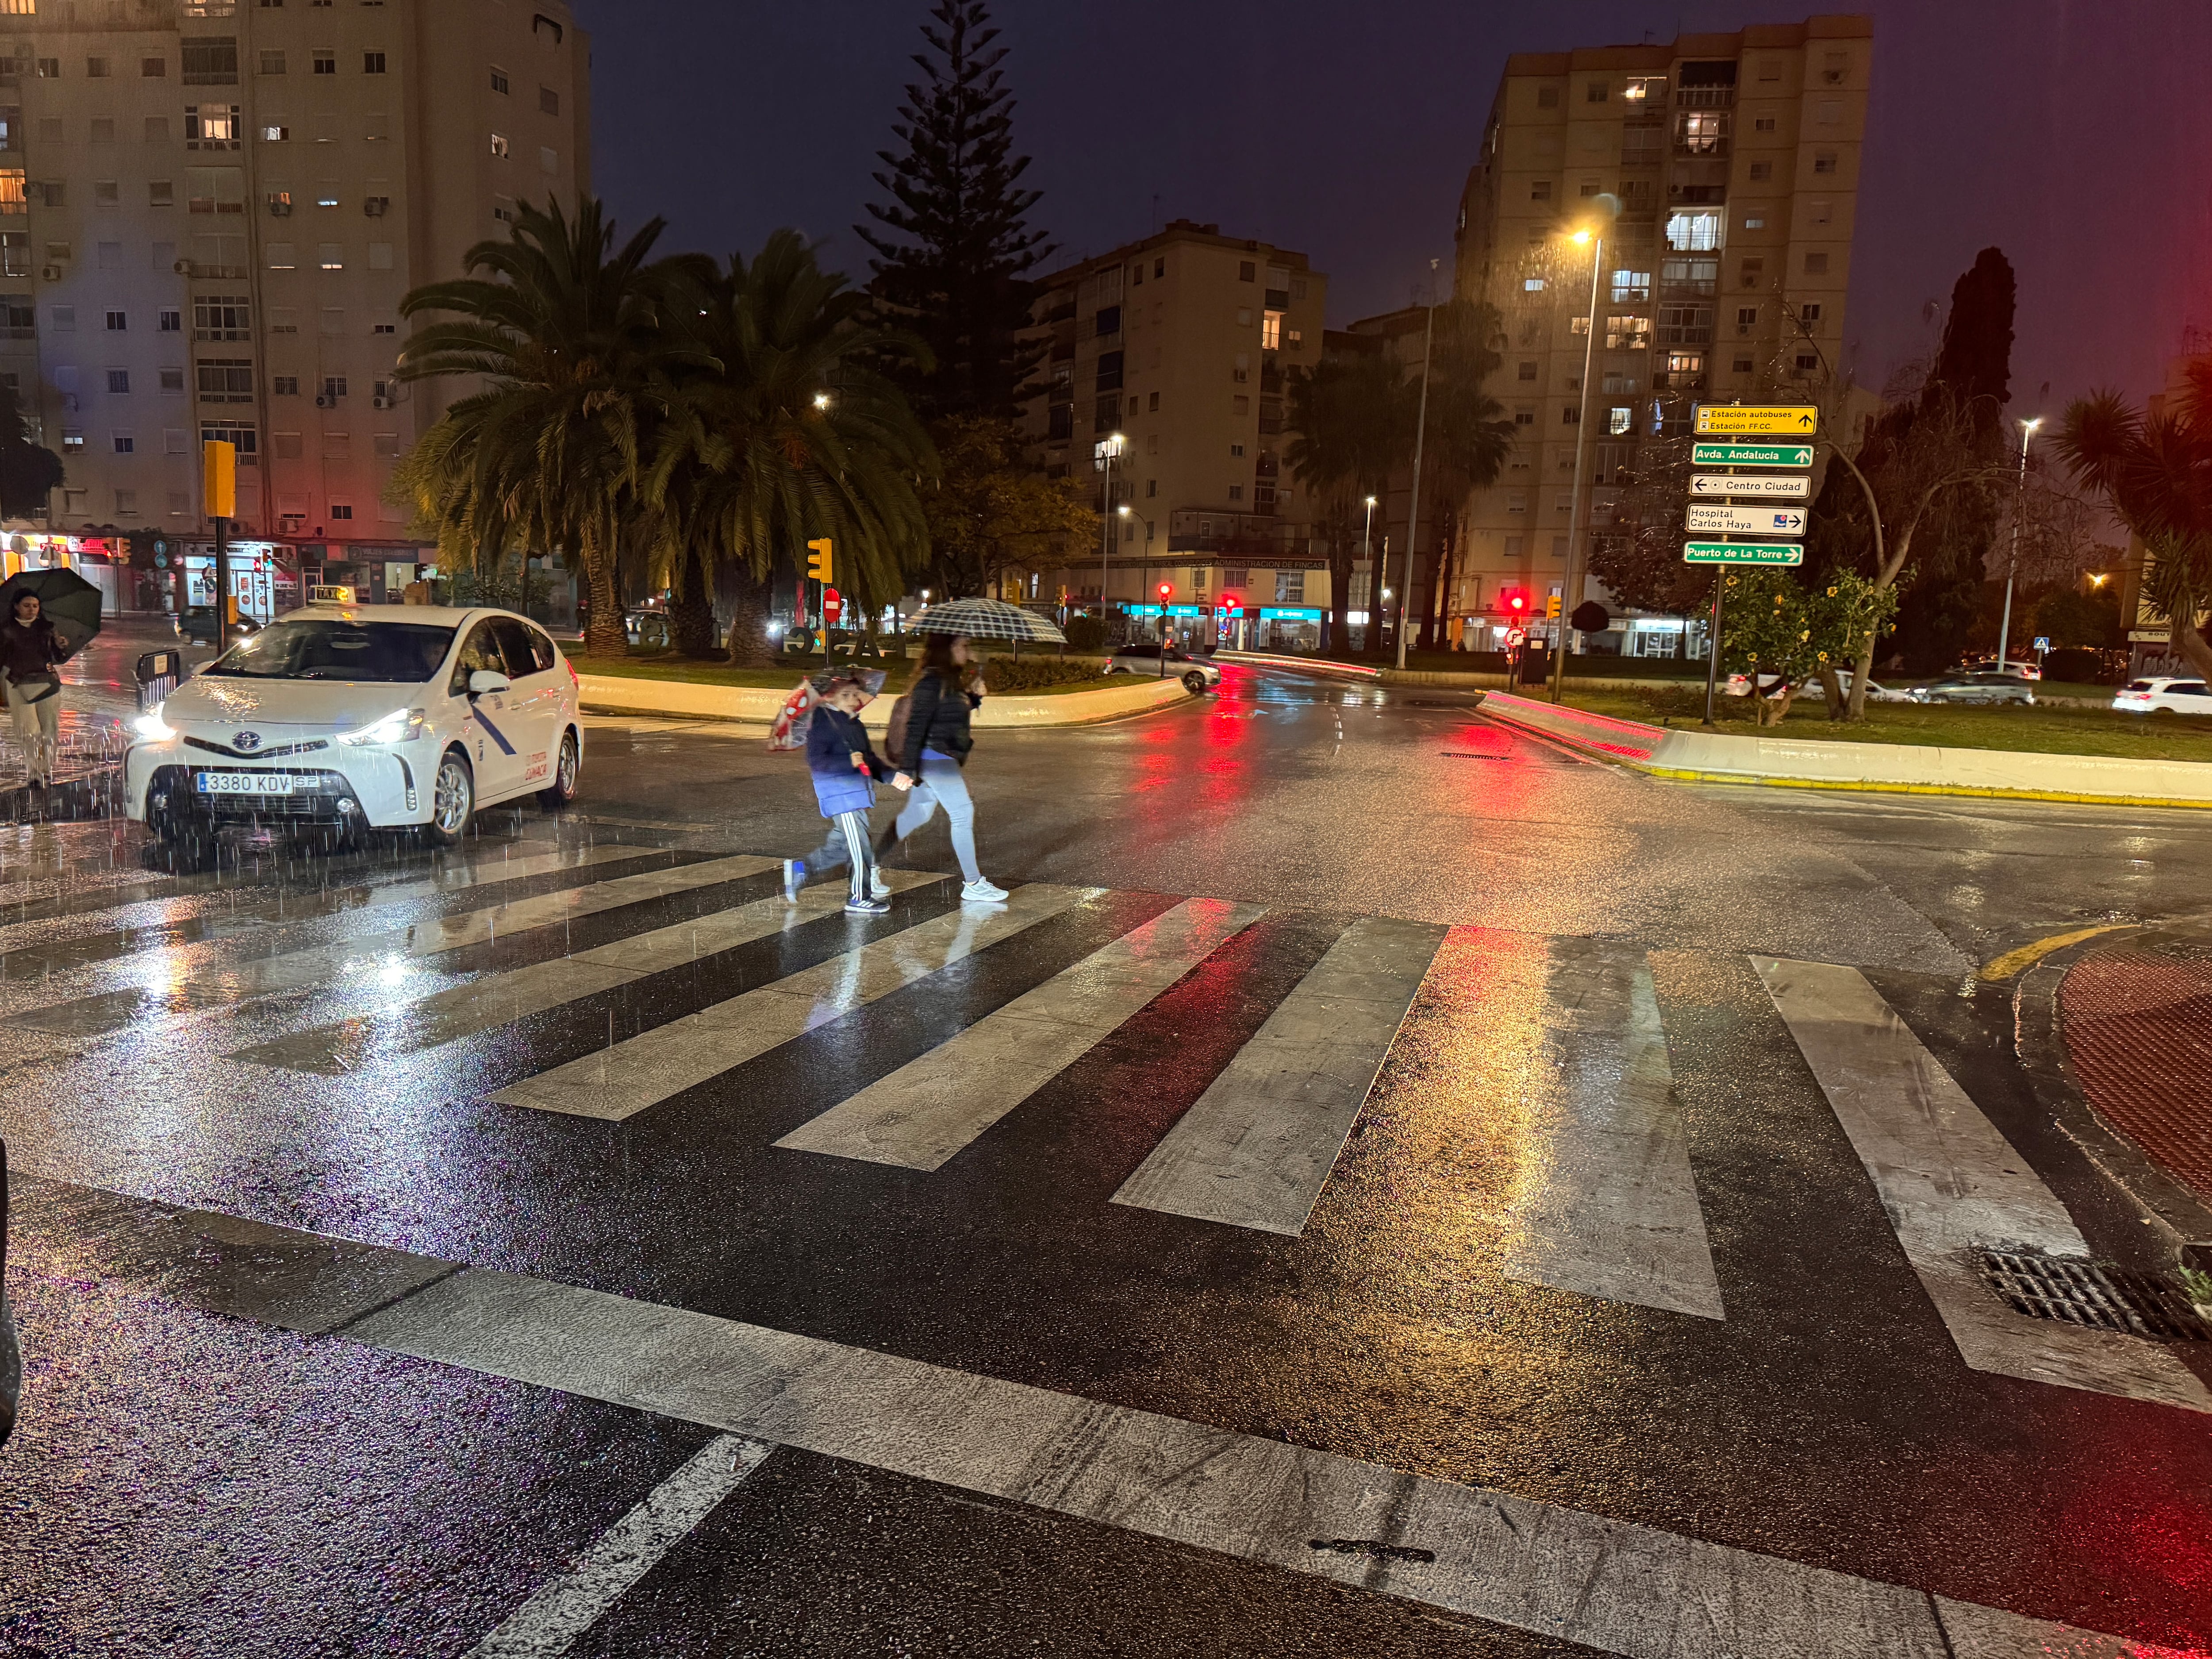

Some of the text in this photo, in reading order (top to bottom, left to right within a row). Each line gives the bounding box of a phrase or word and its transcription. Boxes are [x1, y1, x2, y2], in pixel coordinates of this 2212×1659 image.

[1696, 449, 1779, 460] Avda. Andalucía
[1727, 481, 1801, 491] Centro Ciudad
[1691, 509, 1733, 518] Hospital
[1690, 519, 1751, 530] Carlos Haya
[1688, 548, 1783, 559] Puerto de La Torre
[210, 776, 289, 791] 3380 KDV
[295, 777, 317, 786] SP
